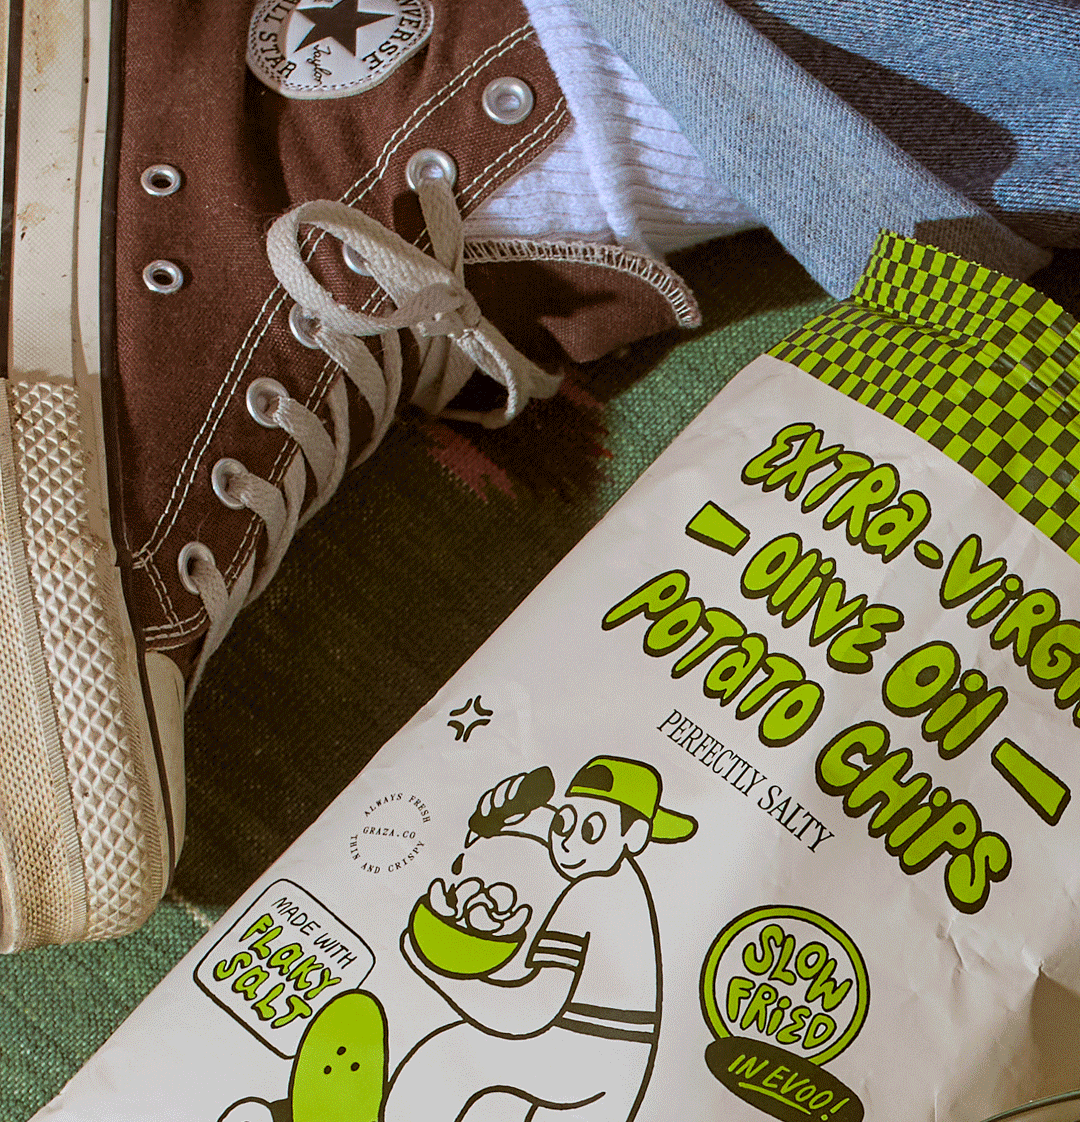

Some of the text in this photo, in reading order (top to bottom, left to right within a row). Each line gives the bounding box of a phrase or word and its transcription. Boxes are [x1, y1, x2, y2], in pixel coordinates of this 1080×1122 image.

[258, 31, 297, 79] STAR
[364, 792, 431, 823] ALWAYS FRESH
[656, 709, 835, 853] PERFECTLY SALTY
[350, 834, 425, 875] THIN AND CRISPY
[362, 826, 416, 839] GRAZA.CO
[271, 897, 358, 970] MADE WITH
[742, 923, 854, 1012] SLOW
[728, 1054, 851, 1122] IN EVOO!
